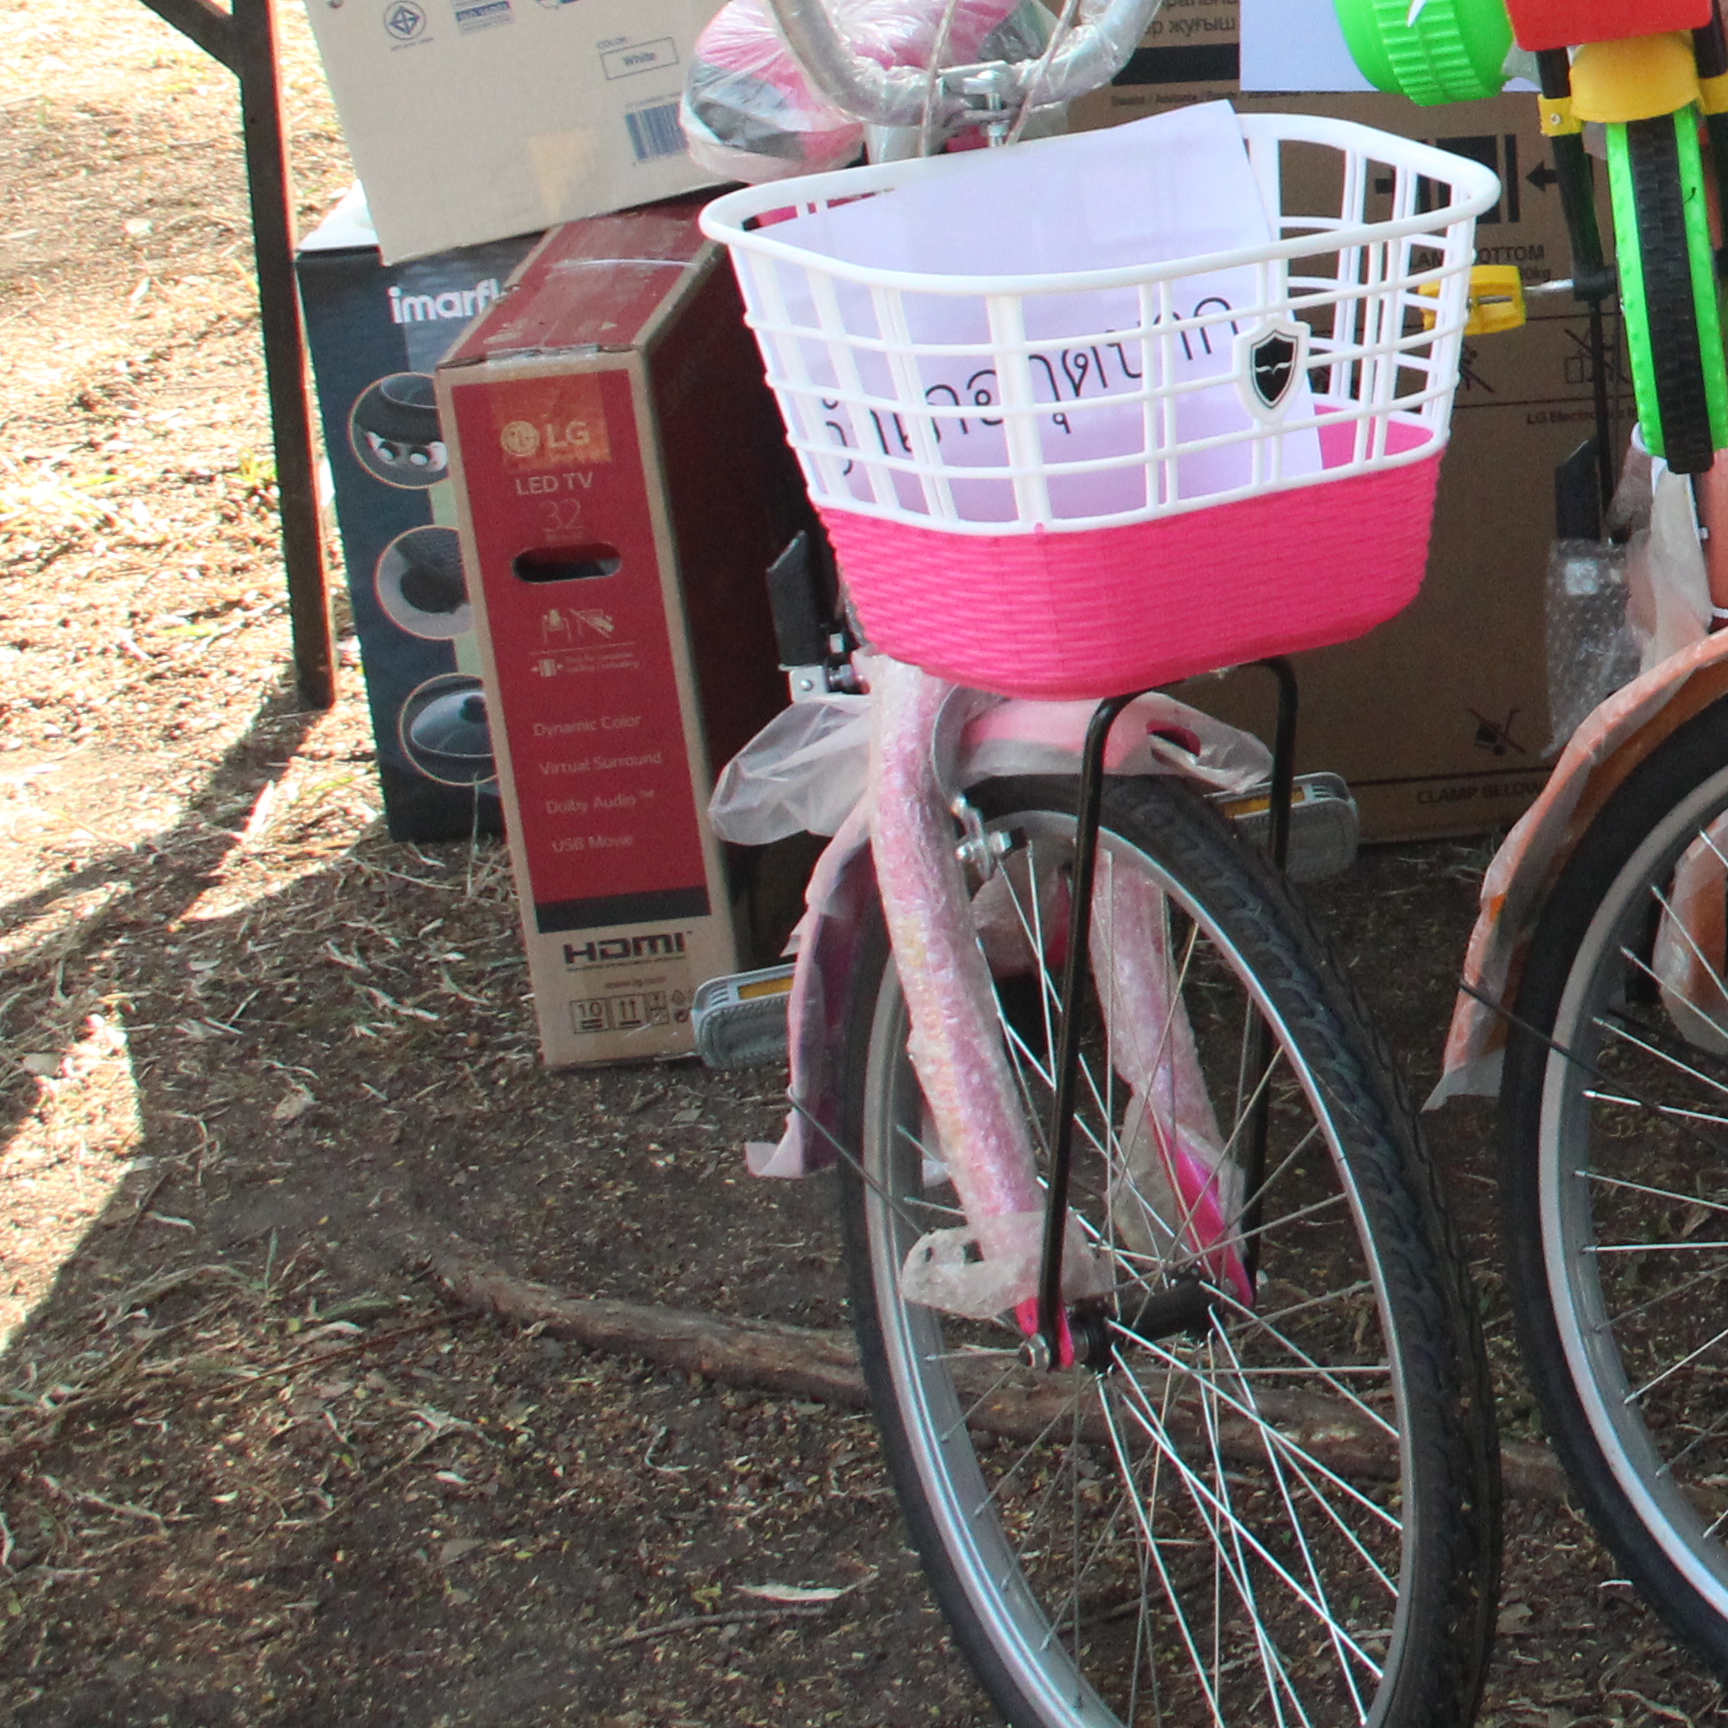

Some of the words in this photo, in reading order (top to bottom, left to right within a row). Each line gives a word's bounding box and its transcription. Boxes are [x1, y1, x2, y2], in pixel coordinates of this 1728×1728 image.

[547, 420, 591, 448] LG
[516, 475, 558, 496] LED
[563, 471, 594, 490] TV
[540, 497, 584, 533] 32
[532, 719, 598, 738] Dynamic
[601, 714, 642, 730] Color
[593, 751, 663, 771] Surround
[564, 931, 686, 966] HDMI
